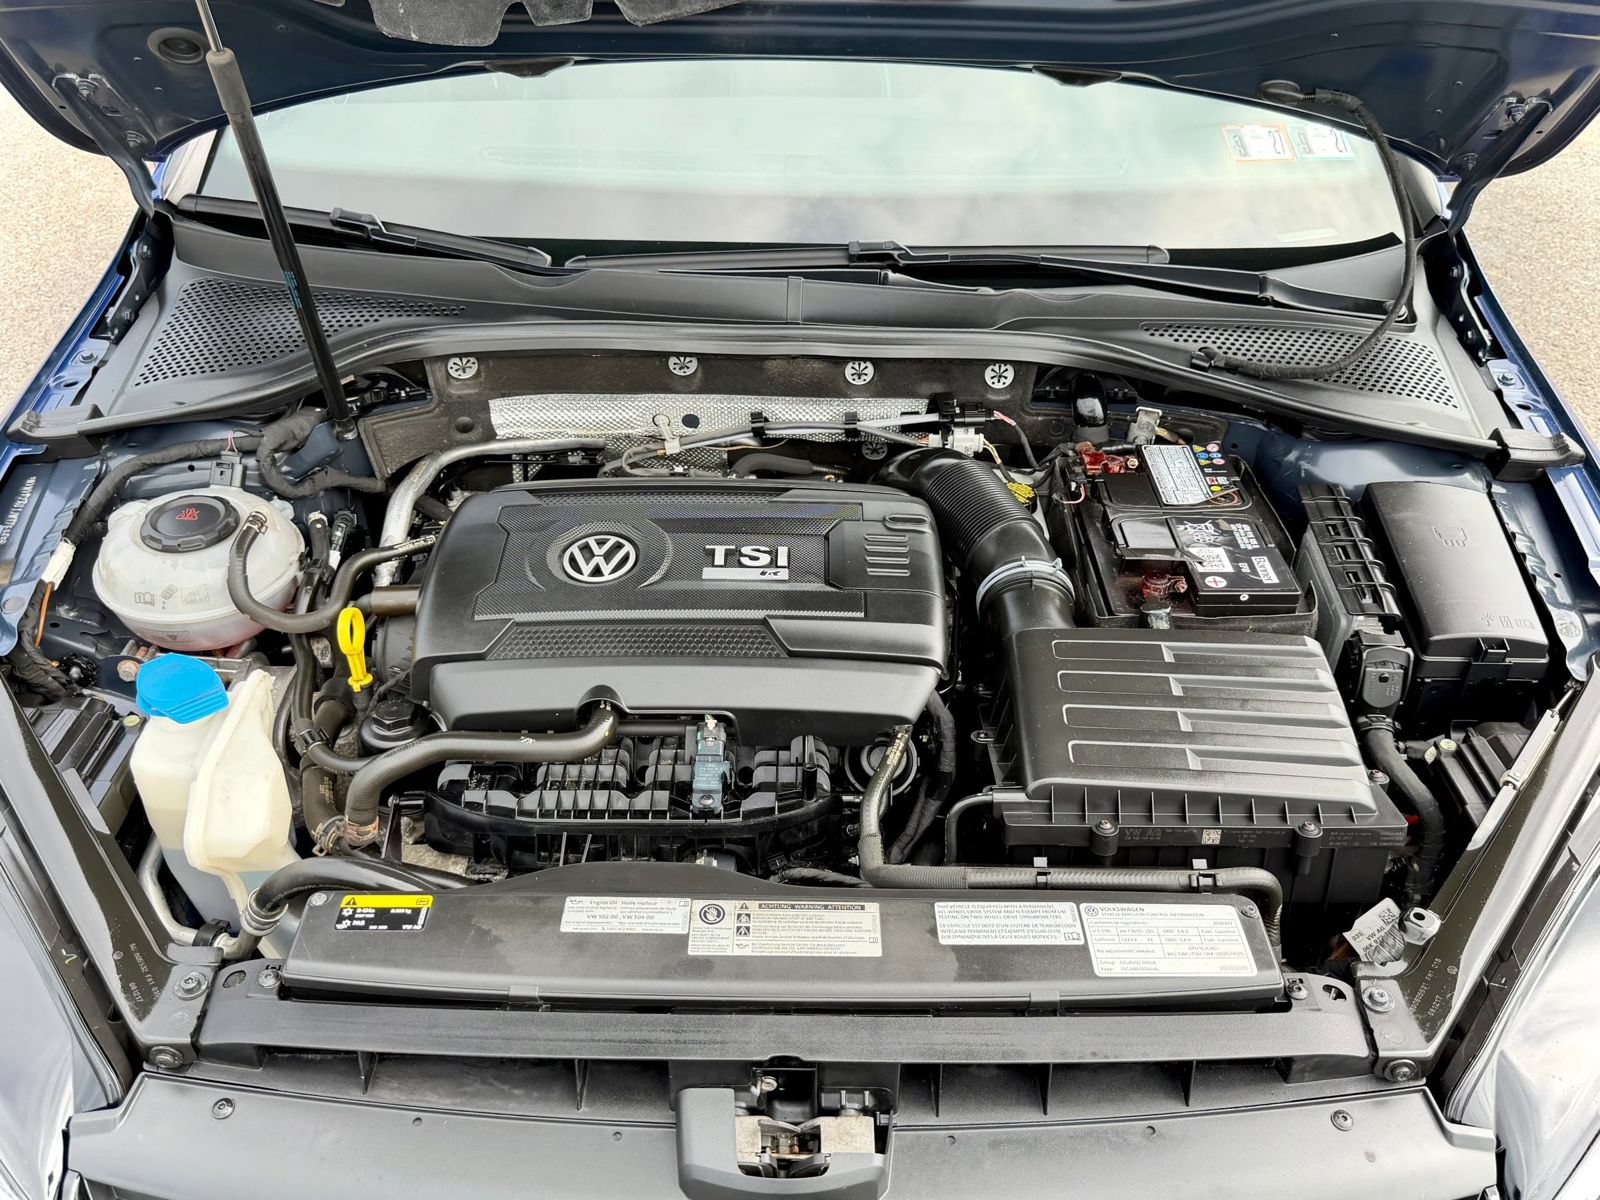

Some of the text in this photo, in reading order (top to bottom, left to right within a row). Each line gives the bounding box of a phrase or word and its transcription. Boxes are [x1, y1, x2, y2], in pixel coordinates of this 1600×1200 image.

[705, 545, 788, 566] TSI
[1366, 932, 1376, 941] VW
[130, 982, 144, 1002] 081217
